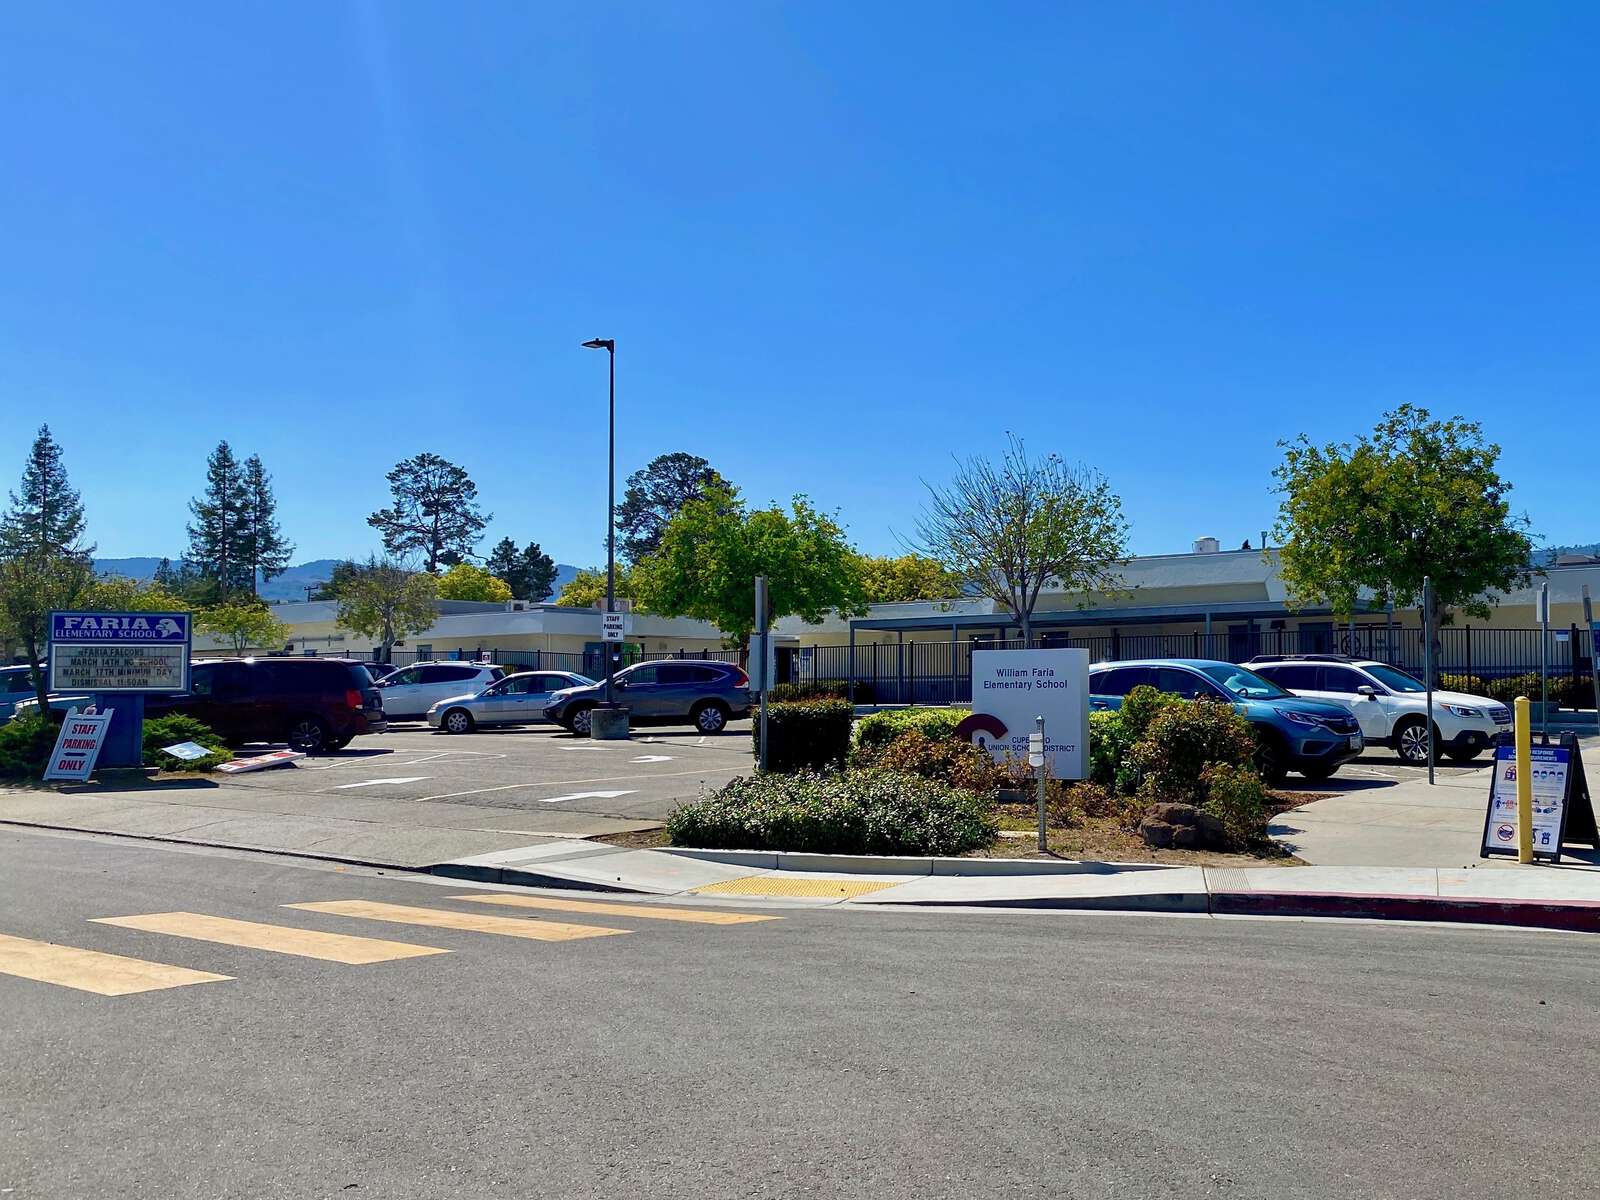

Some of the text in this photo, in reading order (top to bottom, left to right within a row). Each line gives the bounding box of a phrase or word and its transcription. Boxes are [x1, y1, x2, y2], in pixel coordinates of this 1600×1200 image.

[64, 617, 150, 629] FARIA
[55, 629, 158, 638] ELEMENTARY SCHOOL
[70, 658, 98, 666] MARCH
[63, 668, 91, 676] MARCH
[156, 668, 173, 676] DAY
[996, 668, 1054, 677] William Faria
[983, 679, 1068, 690] Elementary School
[71, 723, 98, 734] STAFF
[62, 739, 97, 750] PARKING
[1011, 736, 1051, 744] CUPEO
[1044, 744, 1075, 752] DISTRICT
[58, 760, 85, 770] ONLY
